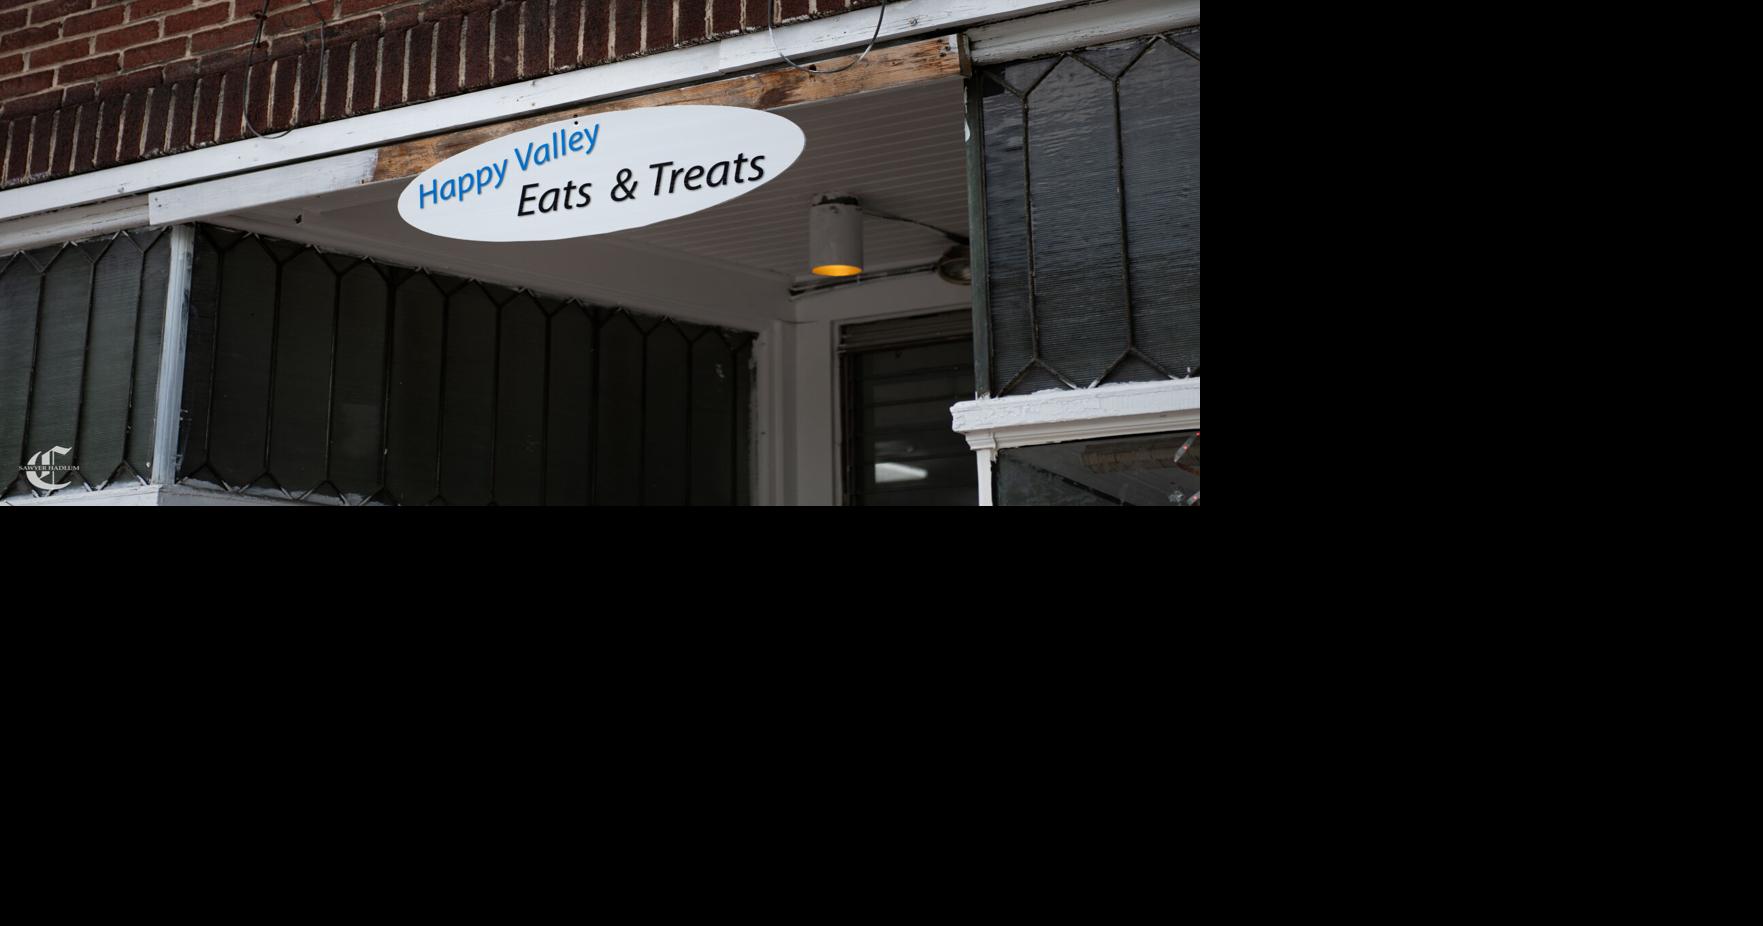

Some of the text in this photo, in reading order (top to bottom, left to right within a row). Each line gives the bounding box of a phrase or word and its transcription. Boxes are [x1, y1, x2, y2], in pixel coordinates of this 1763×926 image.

[418, 123, 600, 209] Happy Valley
[517, 152, 766, 217] Eats & Treats
